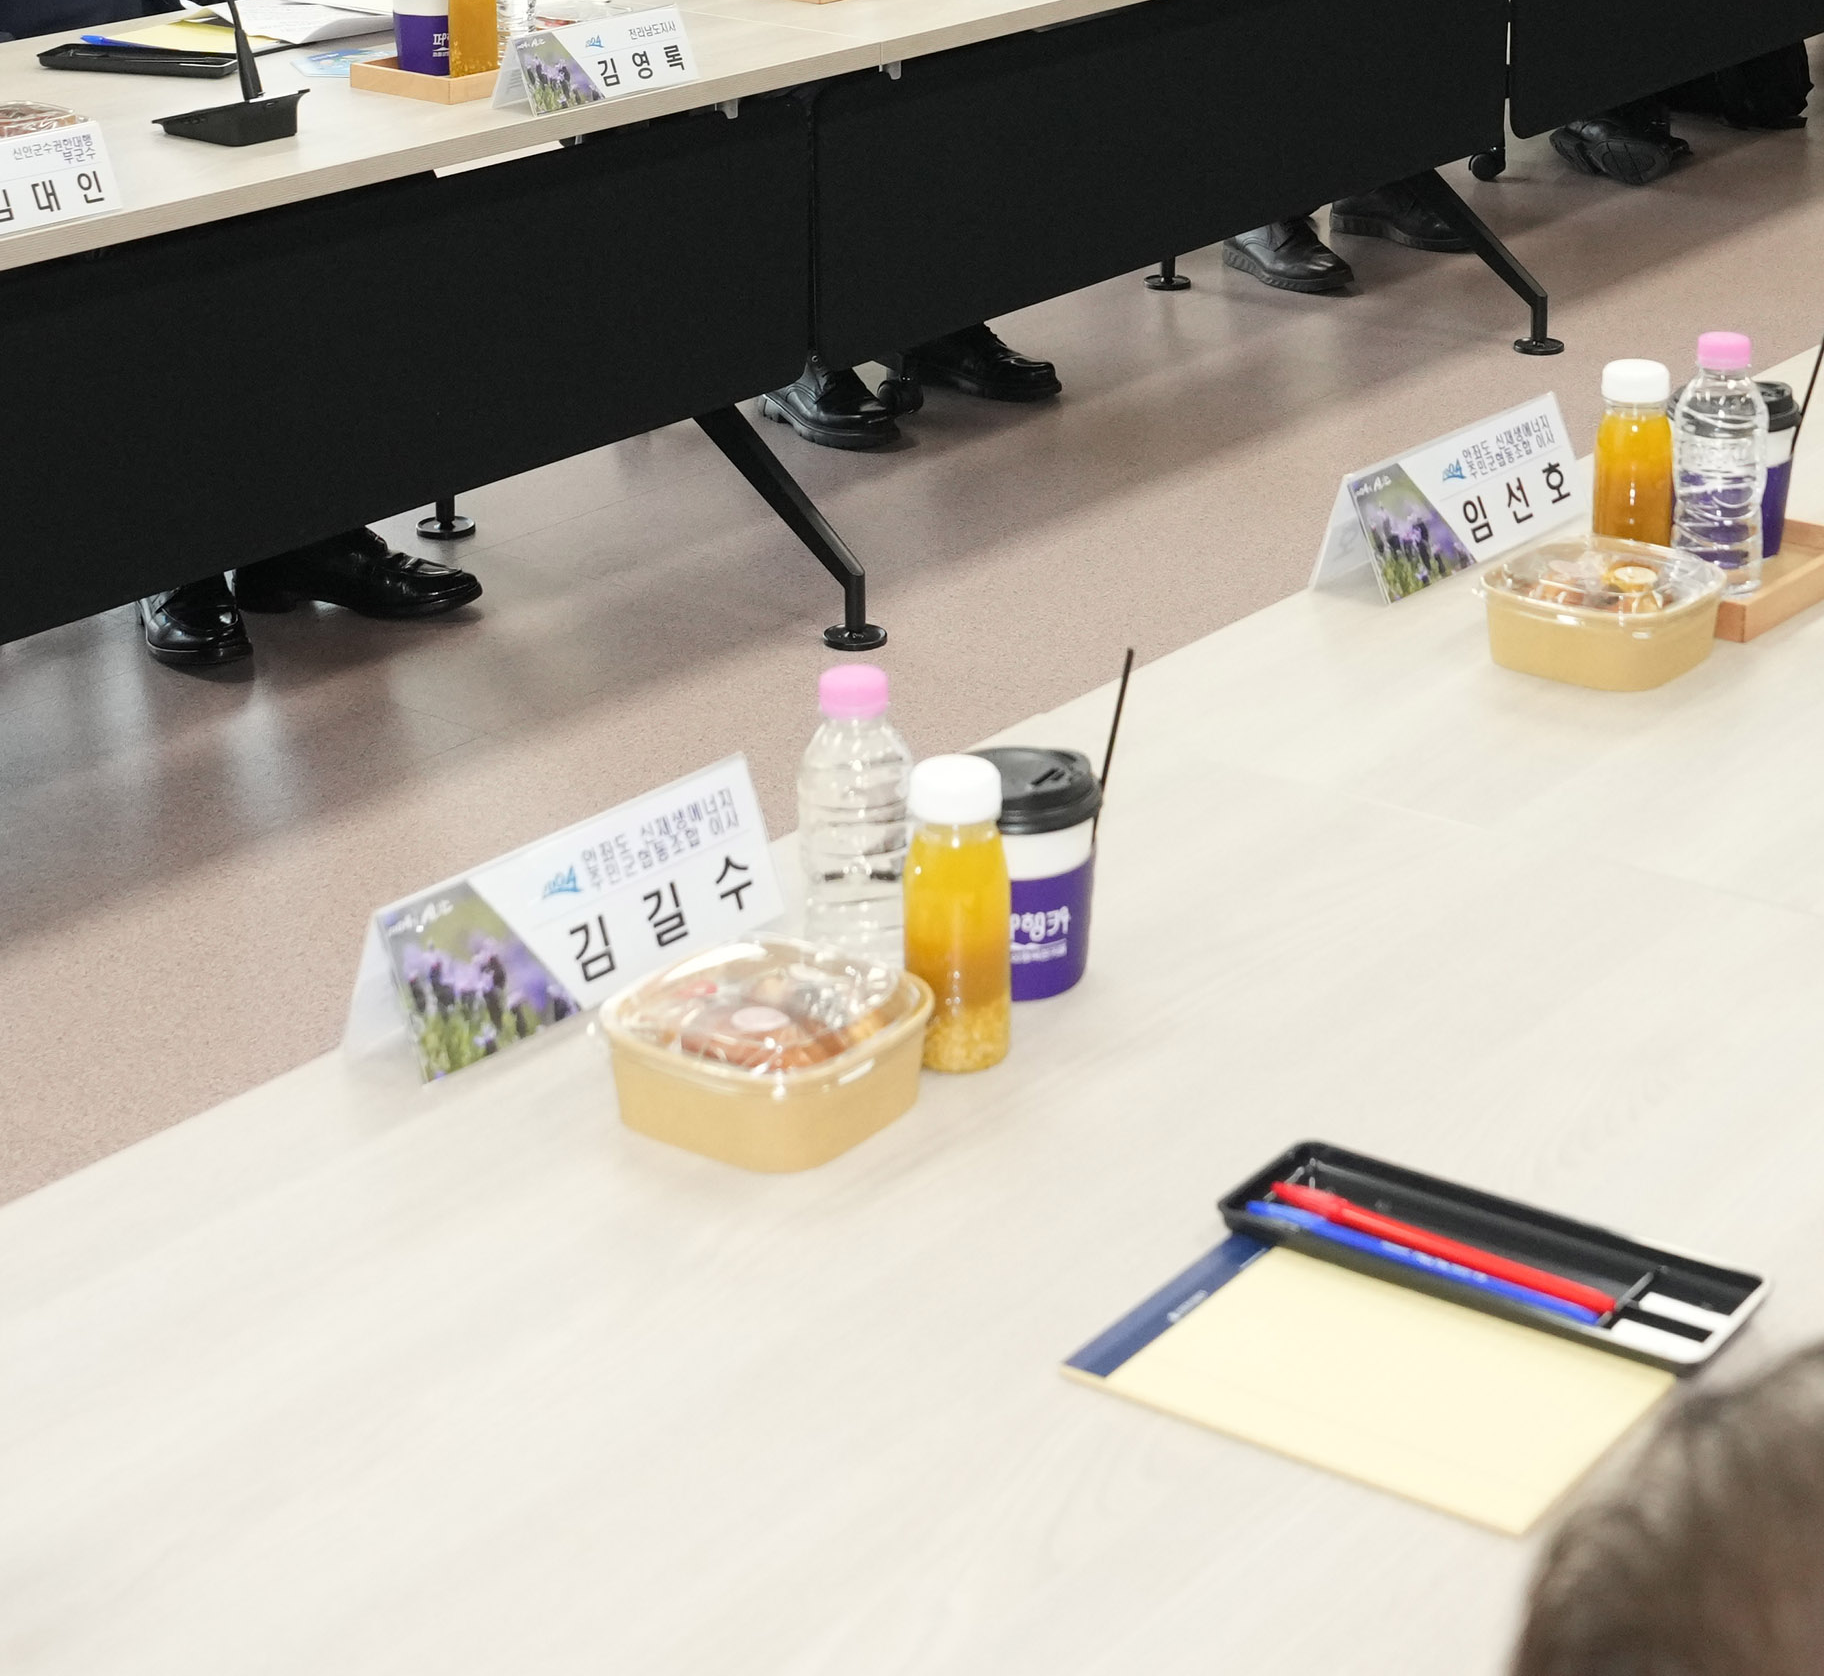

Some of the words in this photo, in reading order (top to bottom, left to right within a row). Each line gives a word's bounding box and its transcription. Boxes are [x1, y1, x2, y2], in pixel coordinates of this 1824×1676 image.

[628, 20, 677, 40] 전라남도지사
[13, 134, 93, 161] 신안군수권한대행
[62, 147, 96, 164] 부군수
